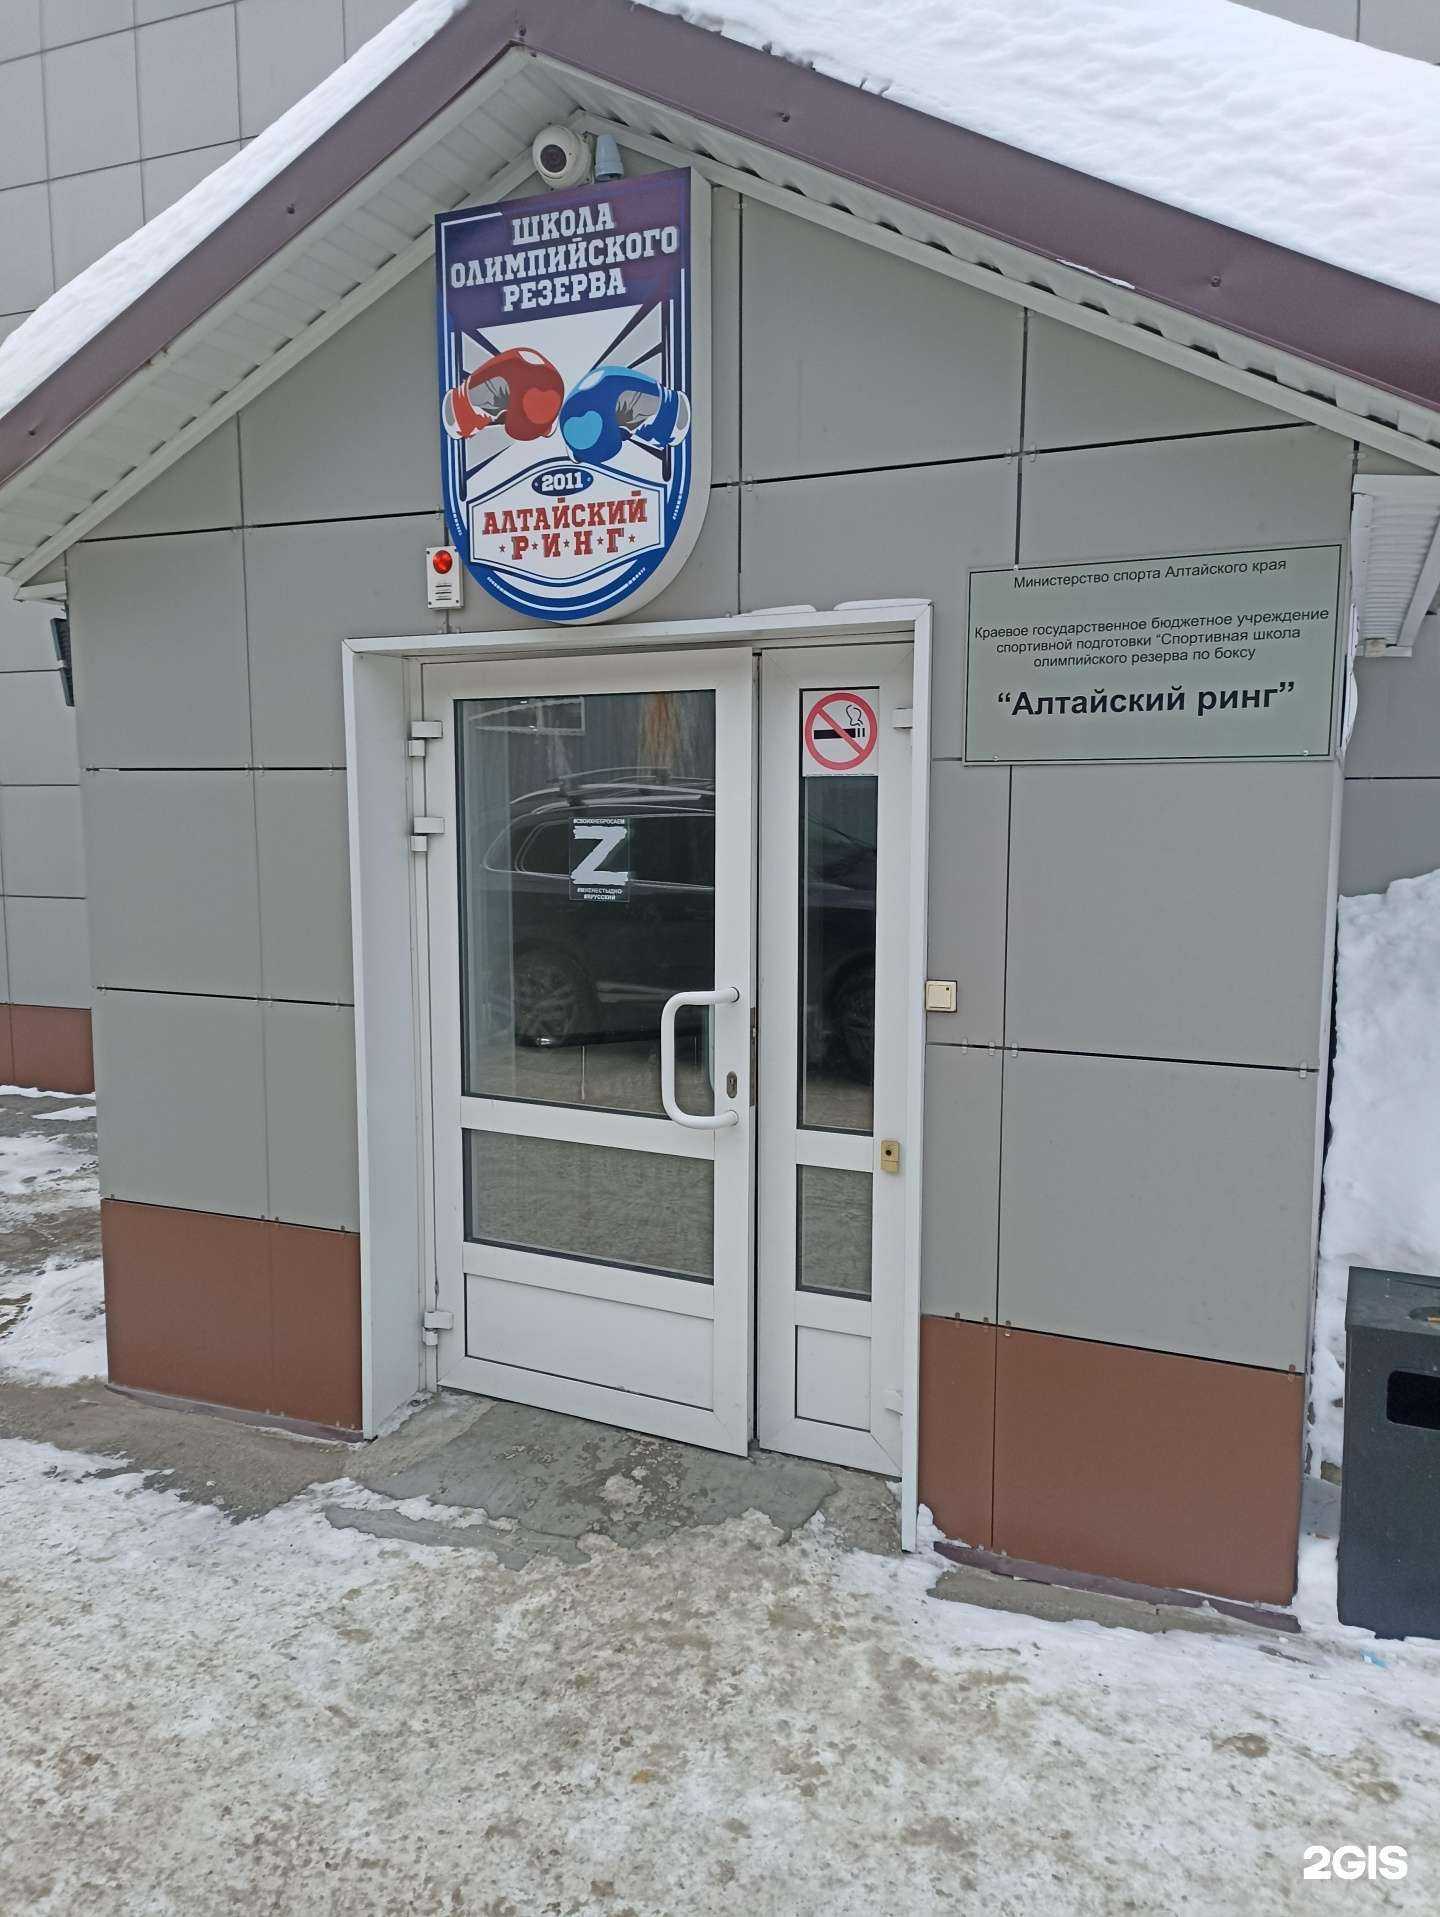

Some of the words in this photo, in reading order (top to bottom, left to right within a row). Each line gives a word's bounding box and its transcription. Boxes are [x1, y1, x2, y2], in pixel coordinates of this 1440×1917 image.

[512, 202, 615, 246] ШКОЛА
[450, 226, 679, 288] ОЛИМПИЙСКОГО
[502, 268, 627, 312] РЕЗЕРВА
[541, 471, 584, 492] 2011
[482, 490, 648, 535] АЛТАЙСКИЙ
[1013, 572, 1109, 589] Министерство
[1113, 568, 1161, 582] спорта
[1165, 562, 1248, 578] Алтайского
[1252, 560, 1287, 574] края
[975, 626, 1029, 640] Краевое
[1032, 619, 1147, 638] государственное
[1151, 614, 1233, 630] бюджетное
[1237, 609, 1329, 628] учреждение
[996, 639, 1072, 655] спортивной
[1076, 635, 1152, 651] подготовки
[1253, 628, 1301, 641] школа
[1033, 653, 1127, 668] олимпийского
[1131, 651, 1188, 666] резерва
[1193, 649, 1210, 661] по
[1214, 647, 1256, 662] боксу
[570, 825, 628, 886] Z
